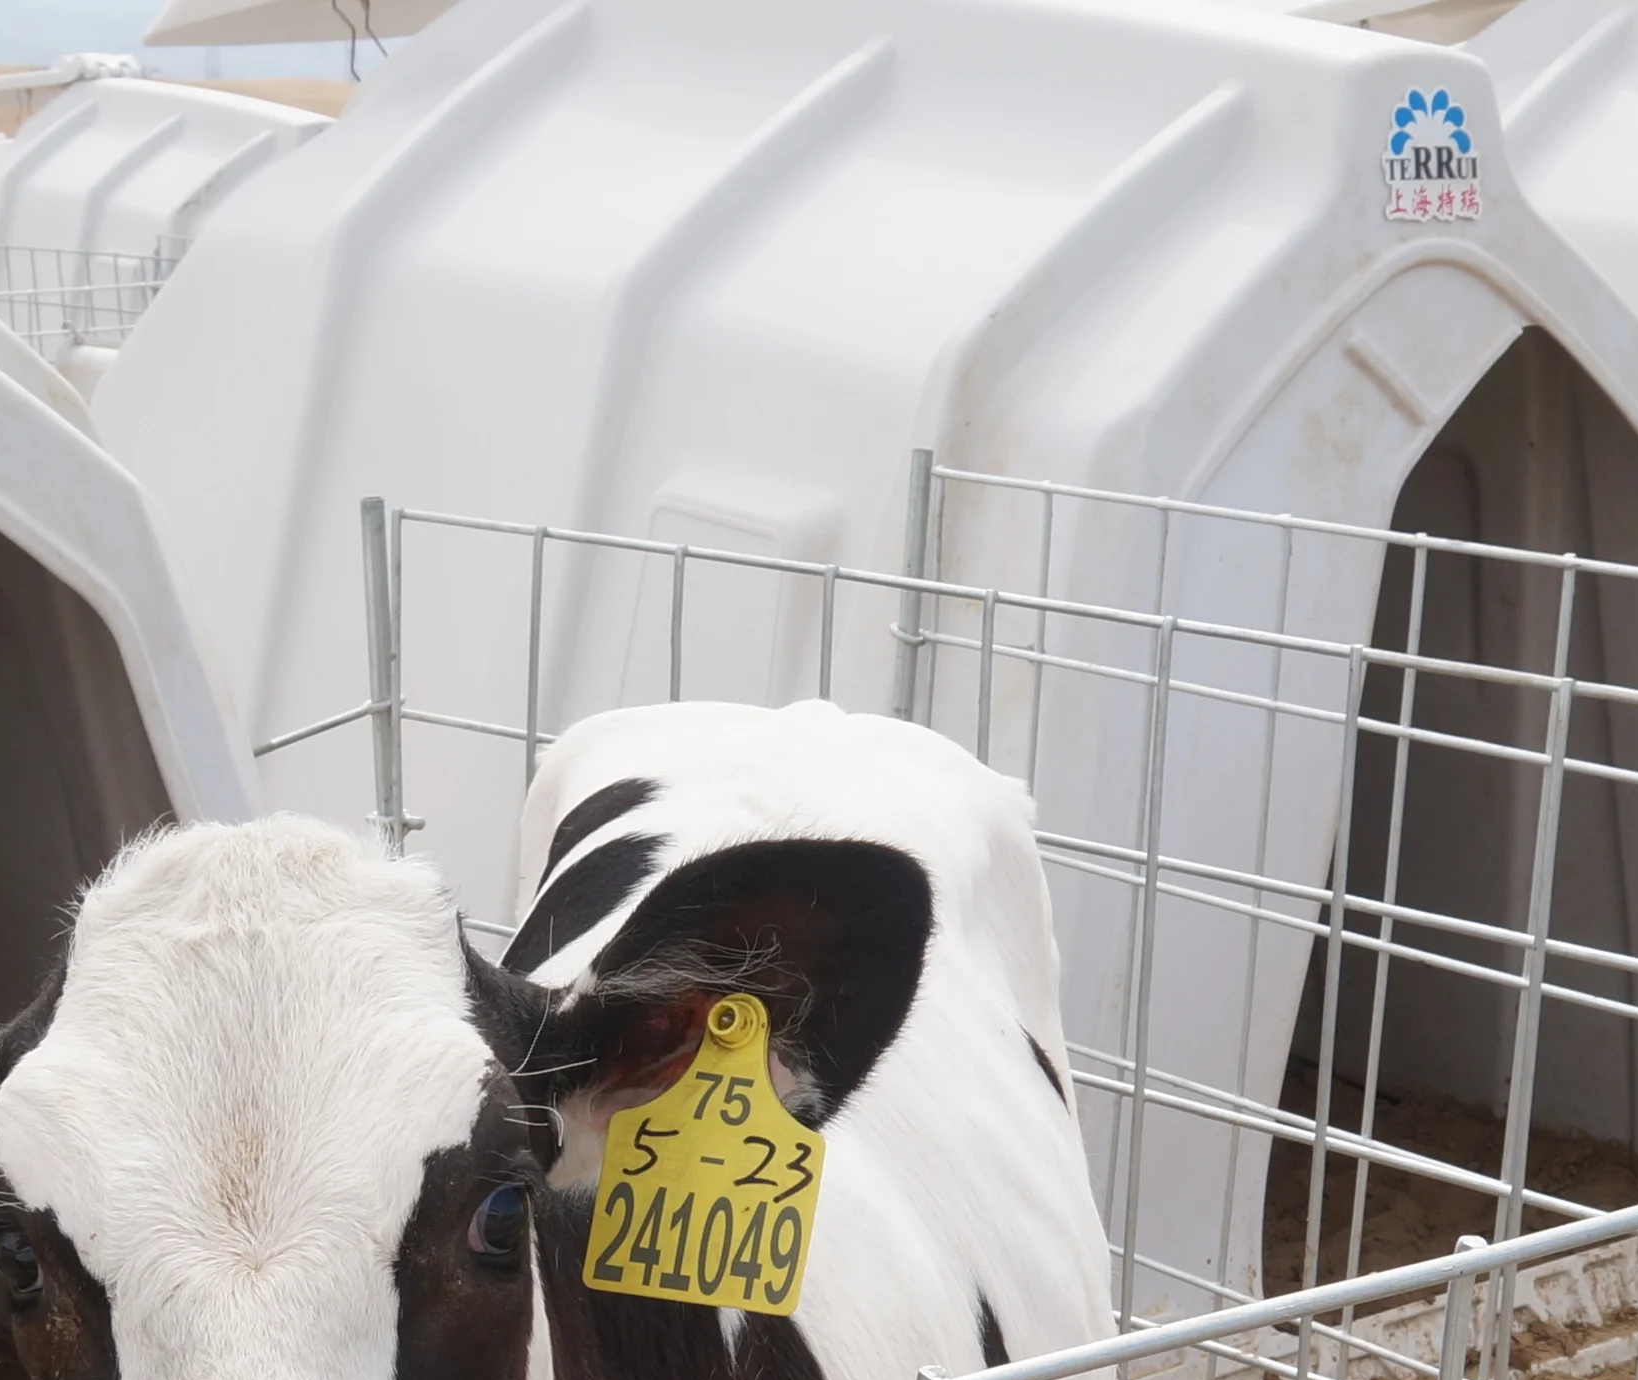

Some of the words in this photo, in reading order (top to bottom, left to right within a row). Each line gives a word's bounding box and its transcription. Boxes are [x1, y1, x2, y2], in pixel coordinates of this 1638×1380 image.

[1385, 145, 1479, 181] TERRUI
[1389, 183, 1480, 217] 上海特瑞
[693, 1071, 755, 1126] 75
[622, 1117, 679, 1176] 5
[733, 1135, 813, 1204] 23
[592, 1181, 803, 1305] 241049
